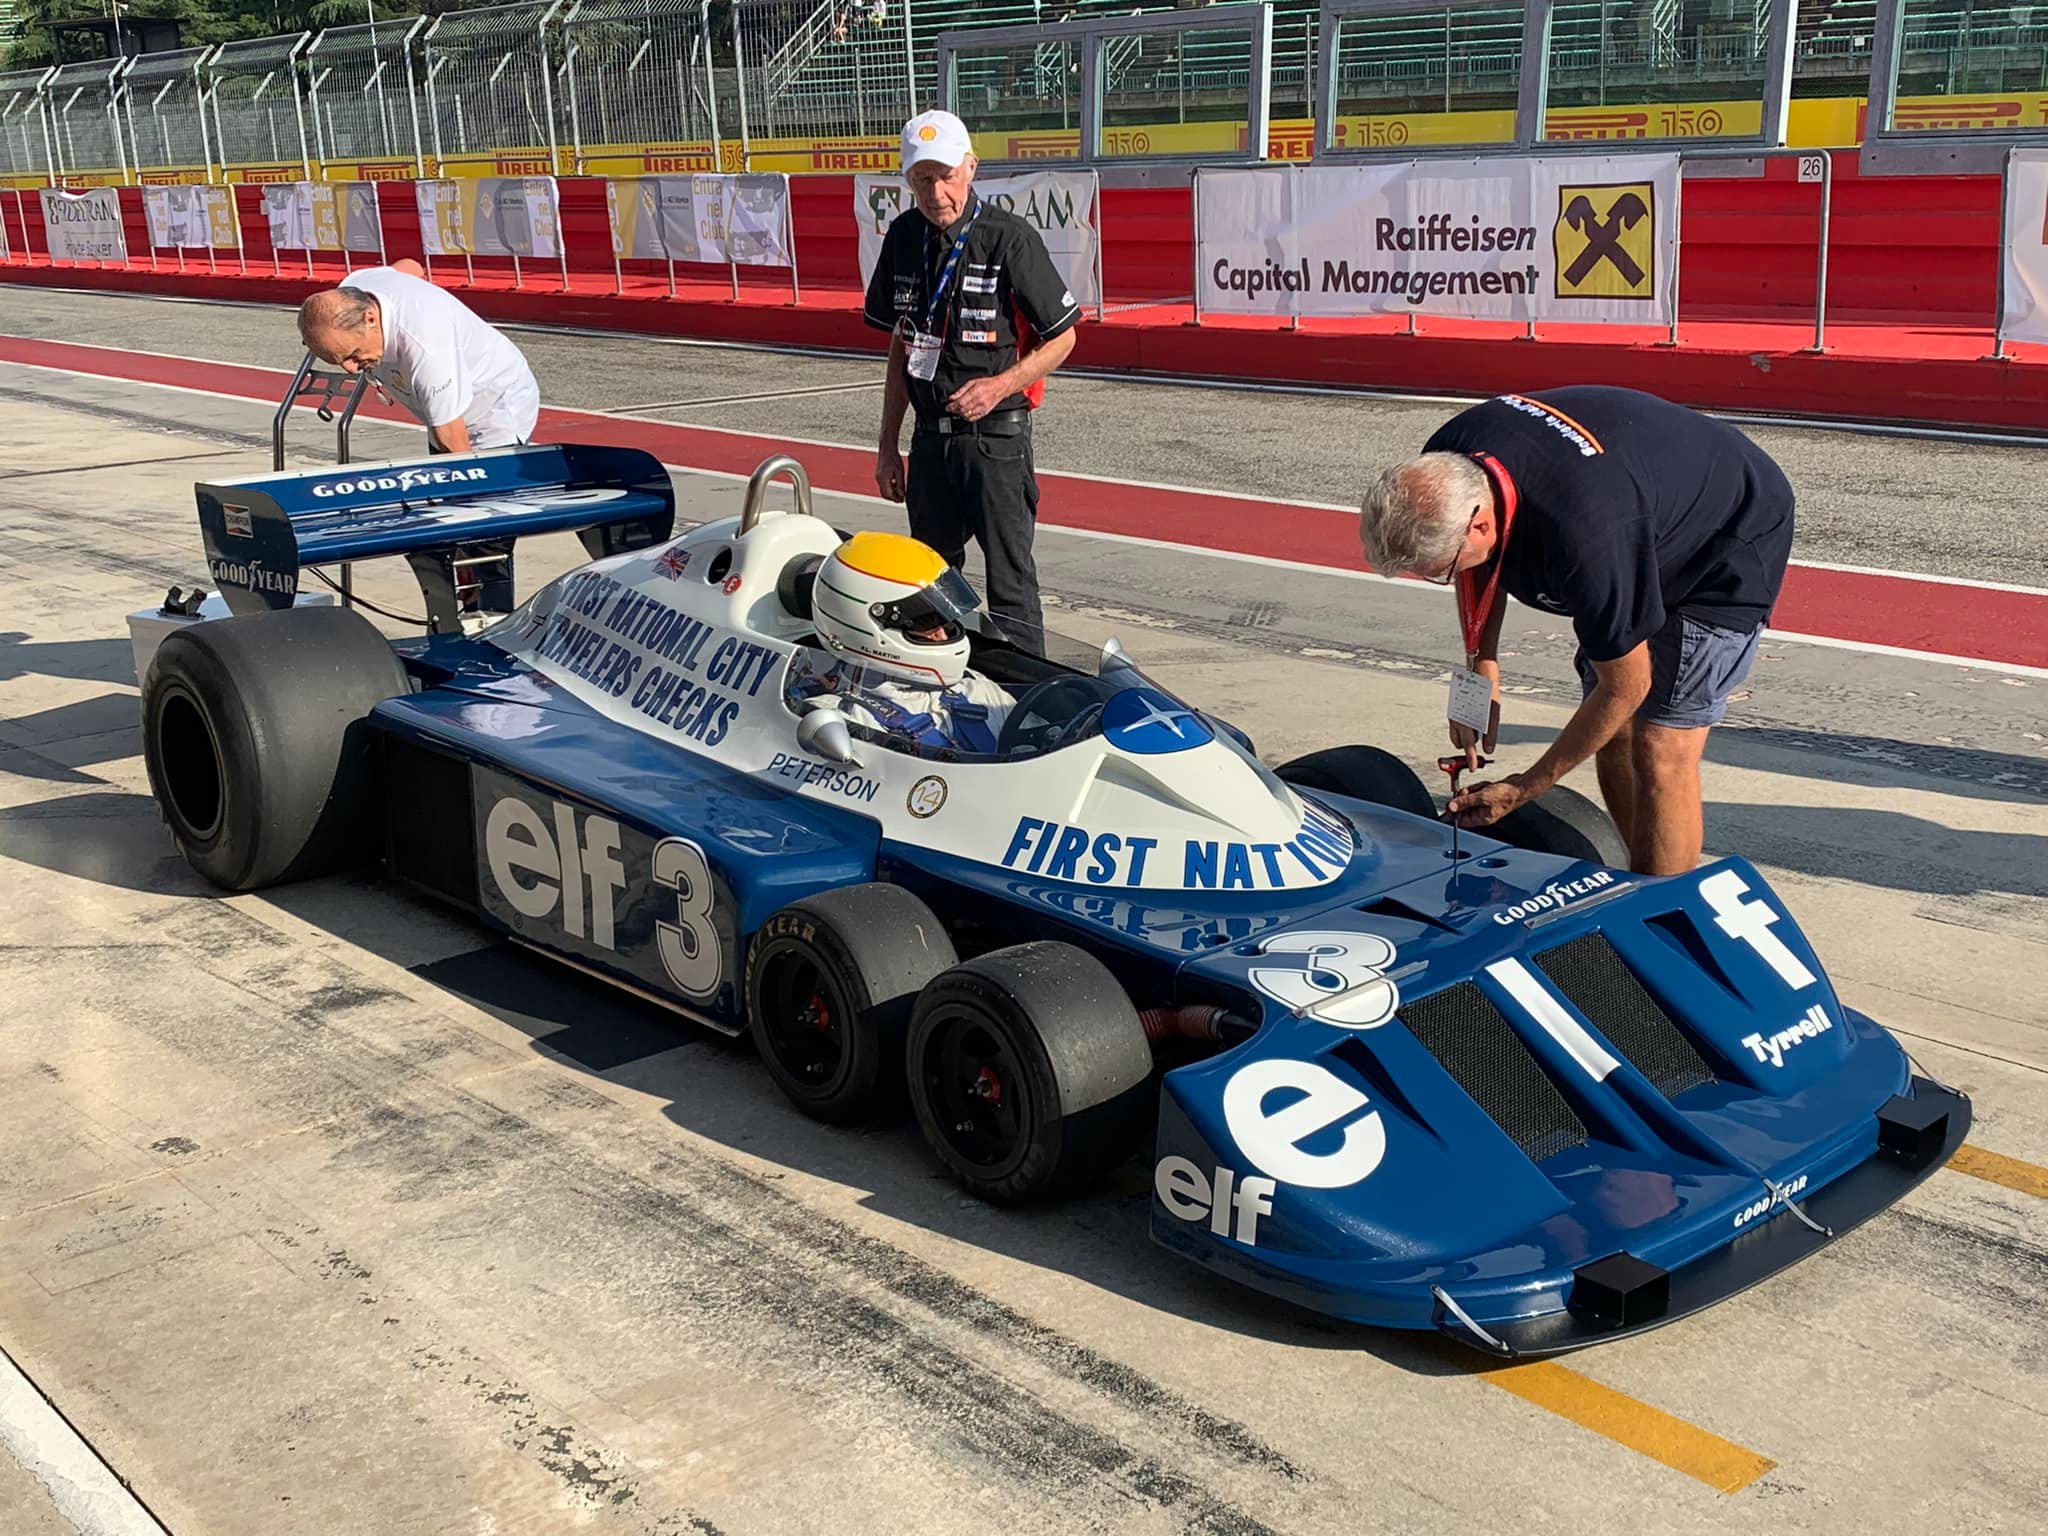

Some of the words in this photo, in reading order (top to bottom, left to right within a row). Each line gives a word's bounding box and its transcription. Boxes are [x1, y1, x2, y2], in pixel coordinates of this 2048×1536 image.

[496, 151, 552, 175] PIRELL
[643, 146, 712, 172] PIRELLI
[812, 142, 890, 169] PIRELLI
[1802, 158, 1821, 177] 26
[693, 176, 722, 195] Entra
[706, 198, 723, 218] nel
[700, 219, 725, 241] Club
[1376, 213, 1537, 252] Raiffeisen
[1213, 257, 1311, 300] Capital
[1323, 260, 1540, 305] Management
[312, 467, 488, 498] GOODYEAR
[209, 559, 295, 595] GOODYEAR
[558, 570, 622, 621] FIRST
[604, 587, 714, 671] NATIONAL
[705, 635, 781, 698] CITY
[534, 612, 641, 699] TRAVELERS
[630, 665, 740, 747] CHECKS
[766, 752, 881, 803] PETERSON
[486, 796, 627, 951] elf
[1000, 815, 1158, 887] FIRST
[651, 835, 723, 998] 3
[1492, 870, 1615, 927] GOODYEAR
[1247, 930, 1400, 1030] 3
[1741, 1003, 1834, 1069] Tyrrell
[1154, 1154, 1277, 1247] elf
